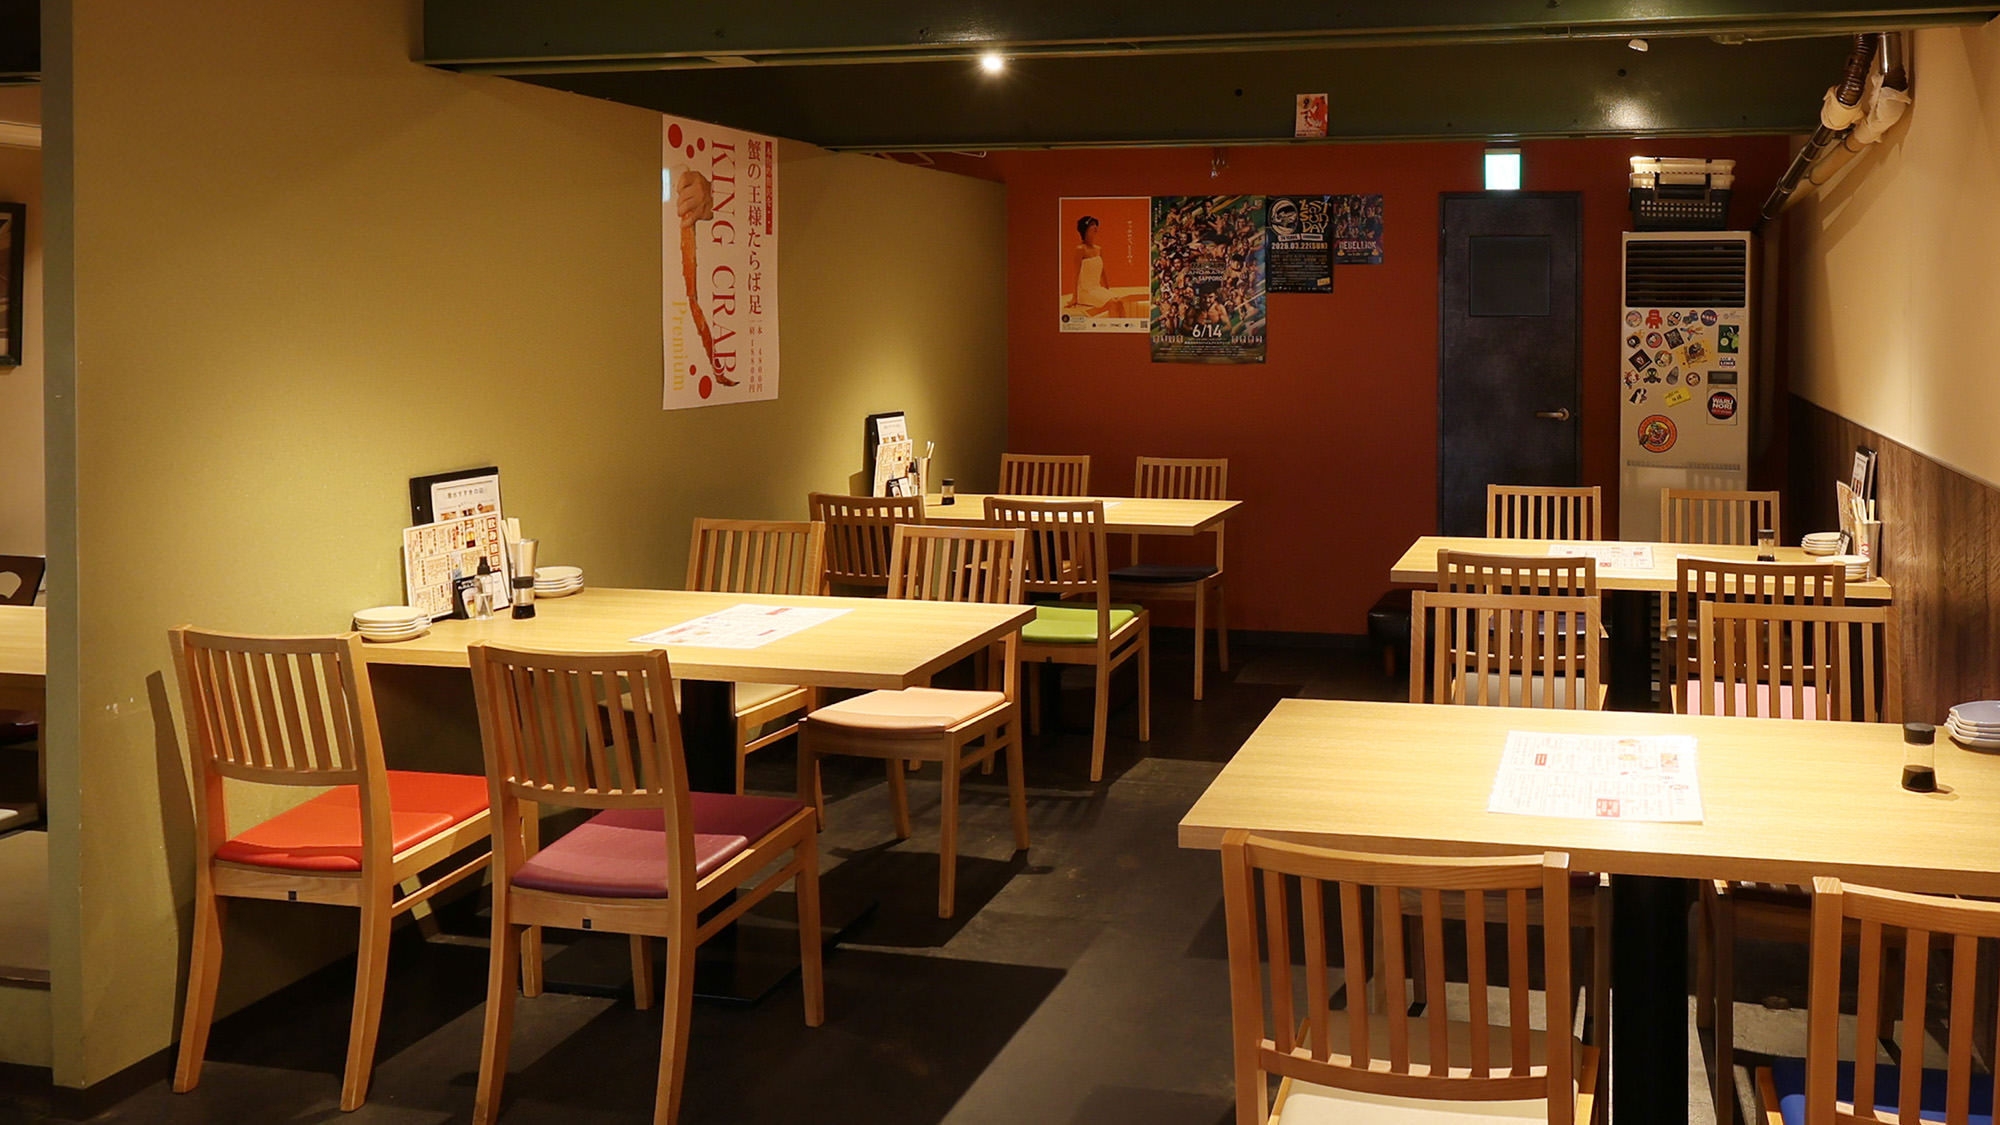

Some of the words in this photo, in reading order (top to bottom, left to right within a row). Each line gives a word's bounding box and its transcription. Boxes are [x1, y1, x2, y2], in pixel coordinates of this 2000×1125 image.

[711, 142, 736, 246] KING
[747, 138, 763, 315] 蟹の王様たらば足
[672, 301, 688, 392] Premium
[711, 264, 737, 375] CRAB
[1192, 324, 1223, 338] 6/14
